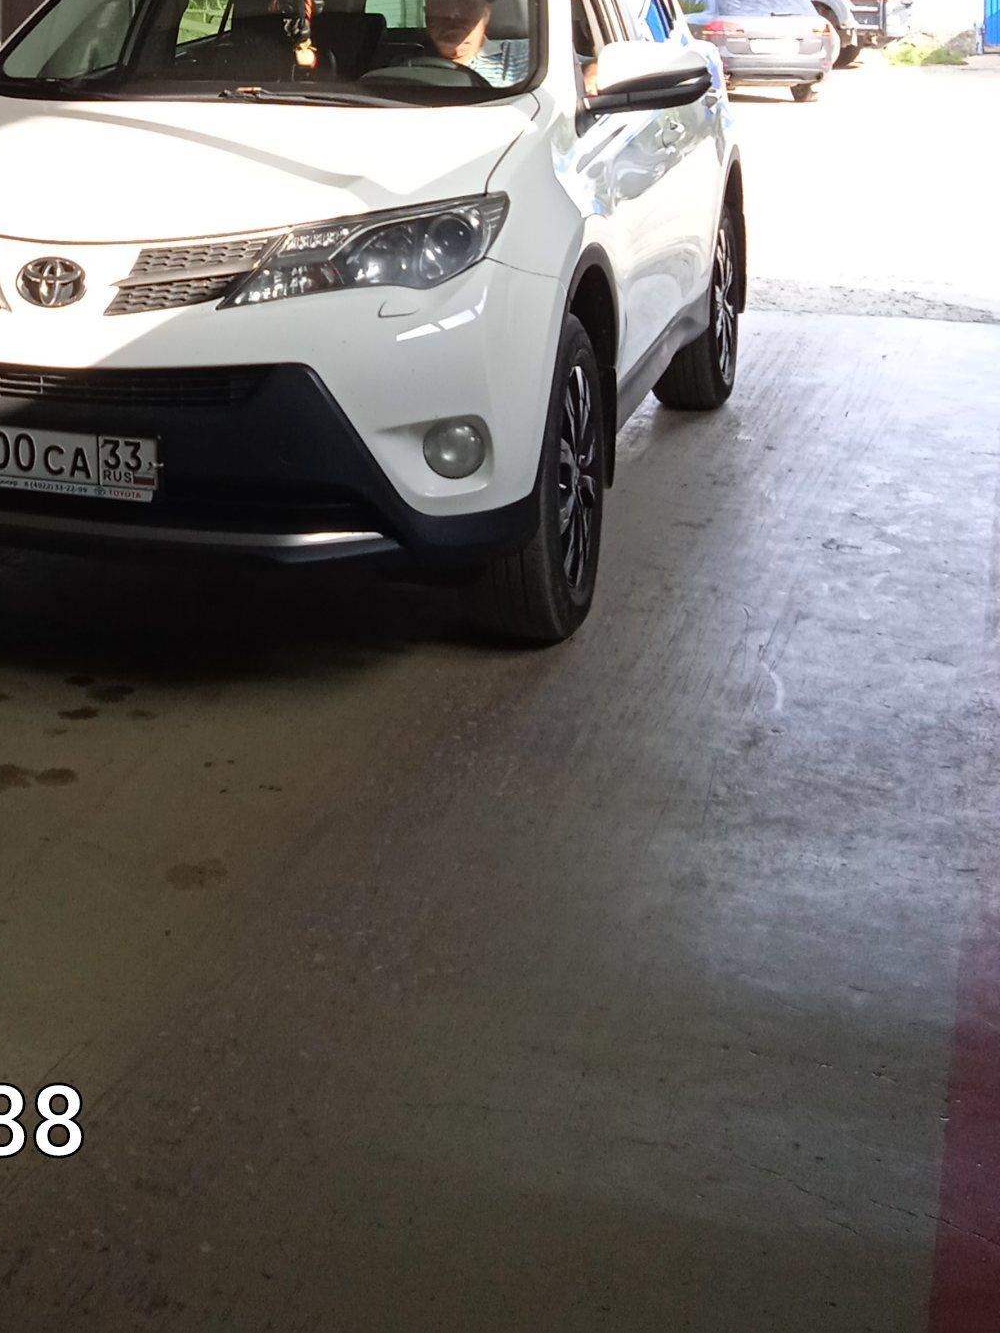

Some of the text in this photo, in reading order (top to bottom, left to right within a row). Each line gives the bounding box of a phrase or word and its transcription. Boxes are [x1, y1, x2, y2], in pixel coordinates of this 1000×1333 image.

[102, 438, 142, 471] 33
[103, 469, 132, 484] RUS
[108, 489, 142, 501] TOYOTA
